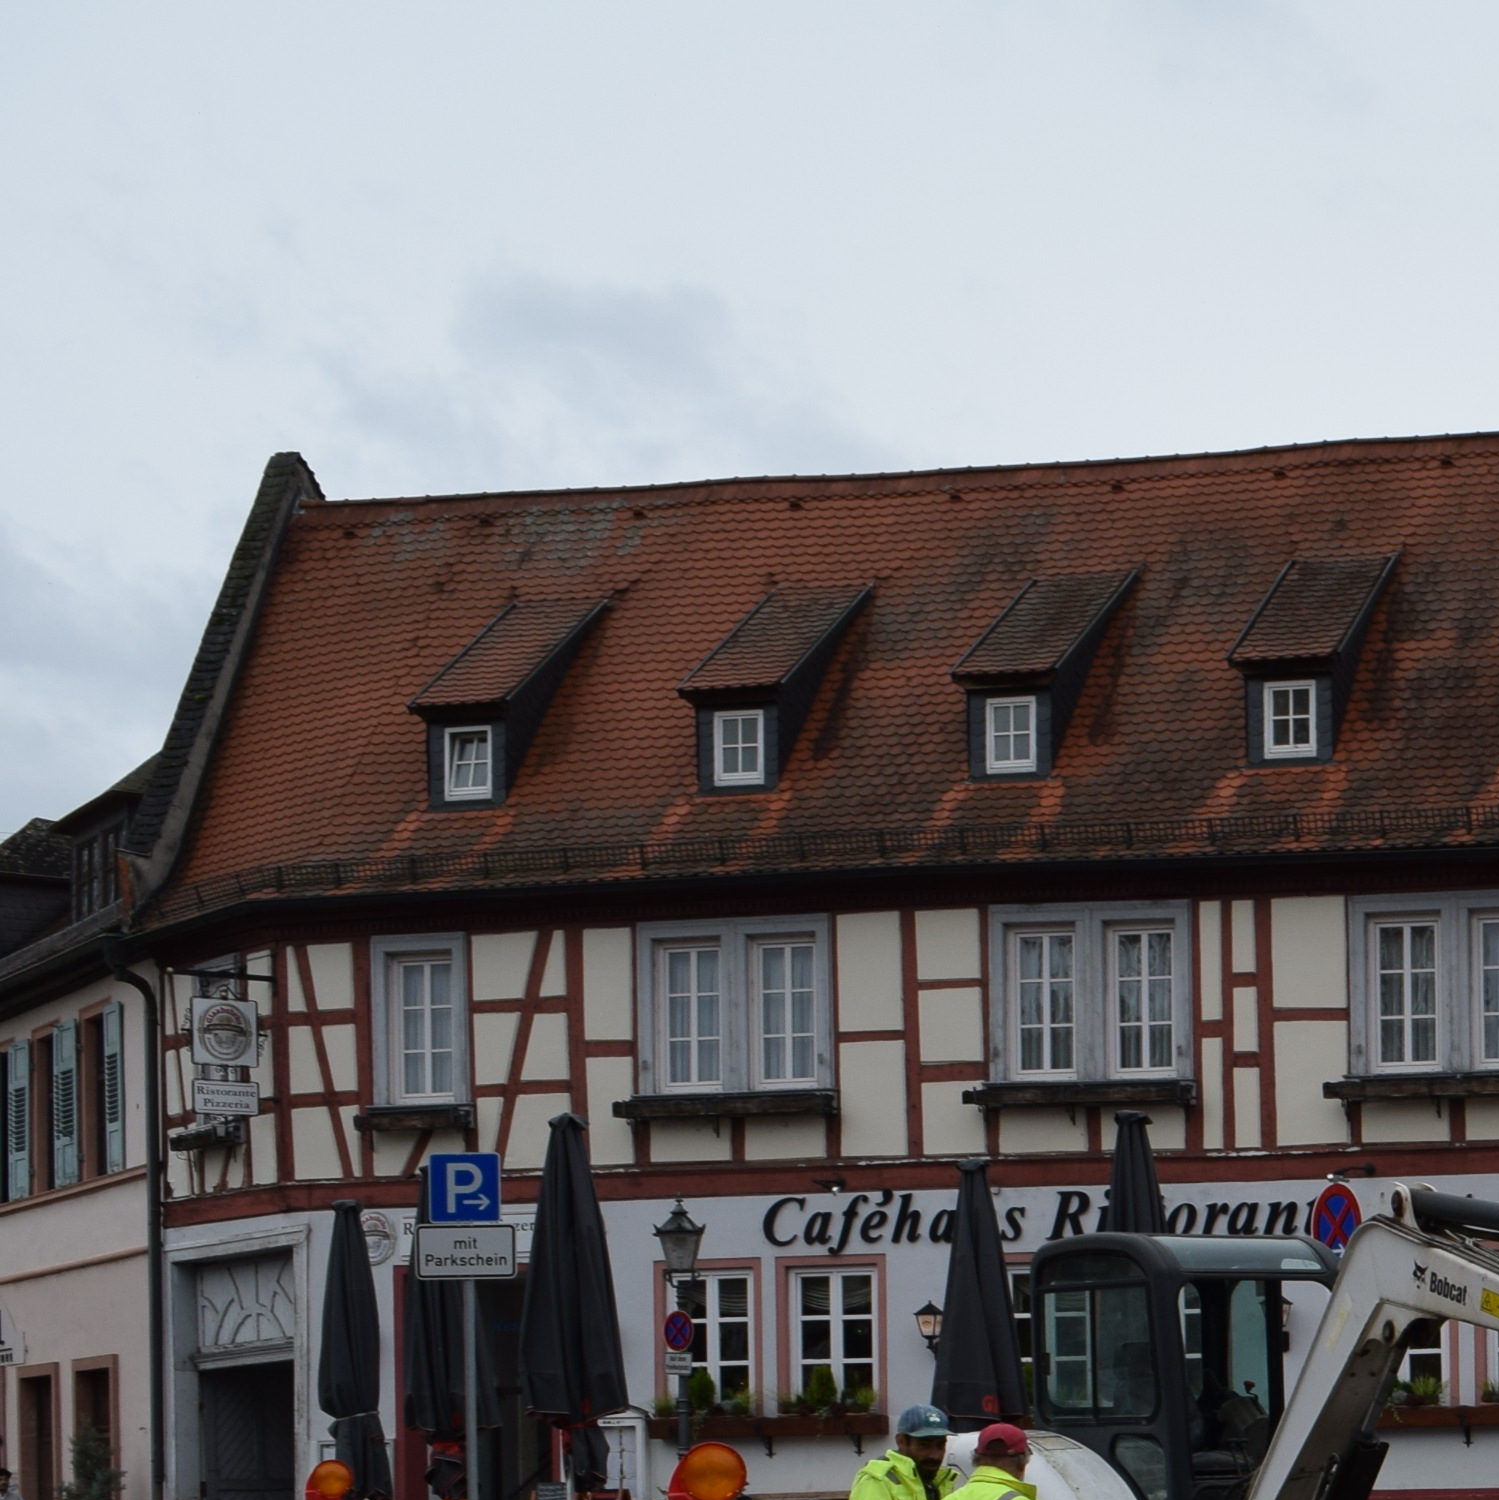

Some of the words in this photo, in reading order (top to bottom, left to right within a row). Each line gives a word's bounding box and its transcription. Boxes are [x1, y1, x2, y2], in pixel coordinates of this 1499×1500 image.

[196, 1085, 257, 1098] Ristorante
[203, 1098, 250, 1109] Pizzeria
[446, 1162, 484, 1214] P
[763, 1188, 1026, 1255] Caféhas
[454, 1237, 478, 1250] mit
[425, 1253, 508, 1267] Parkschein
[1429, 1271, 1467, 1305] Bobcat
